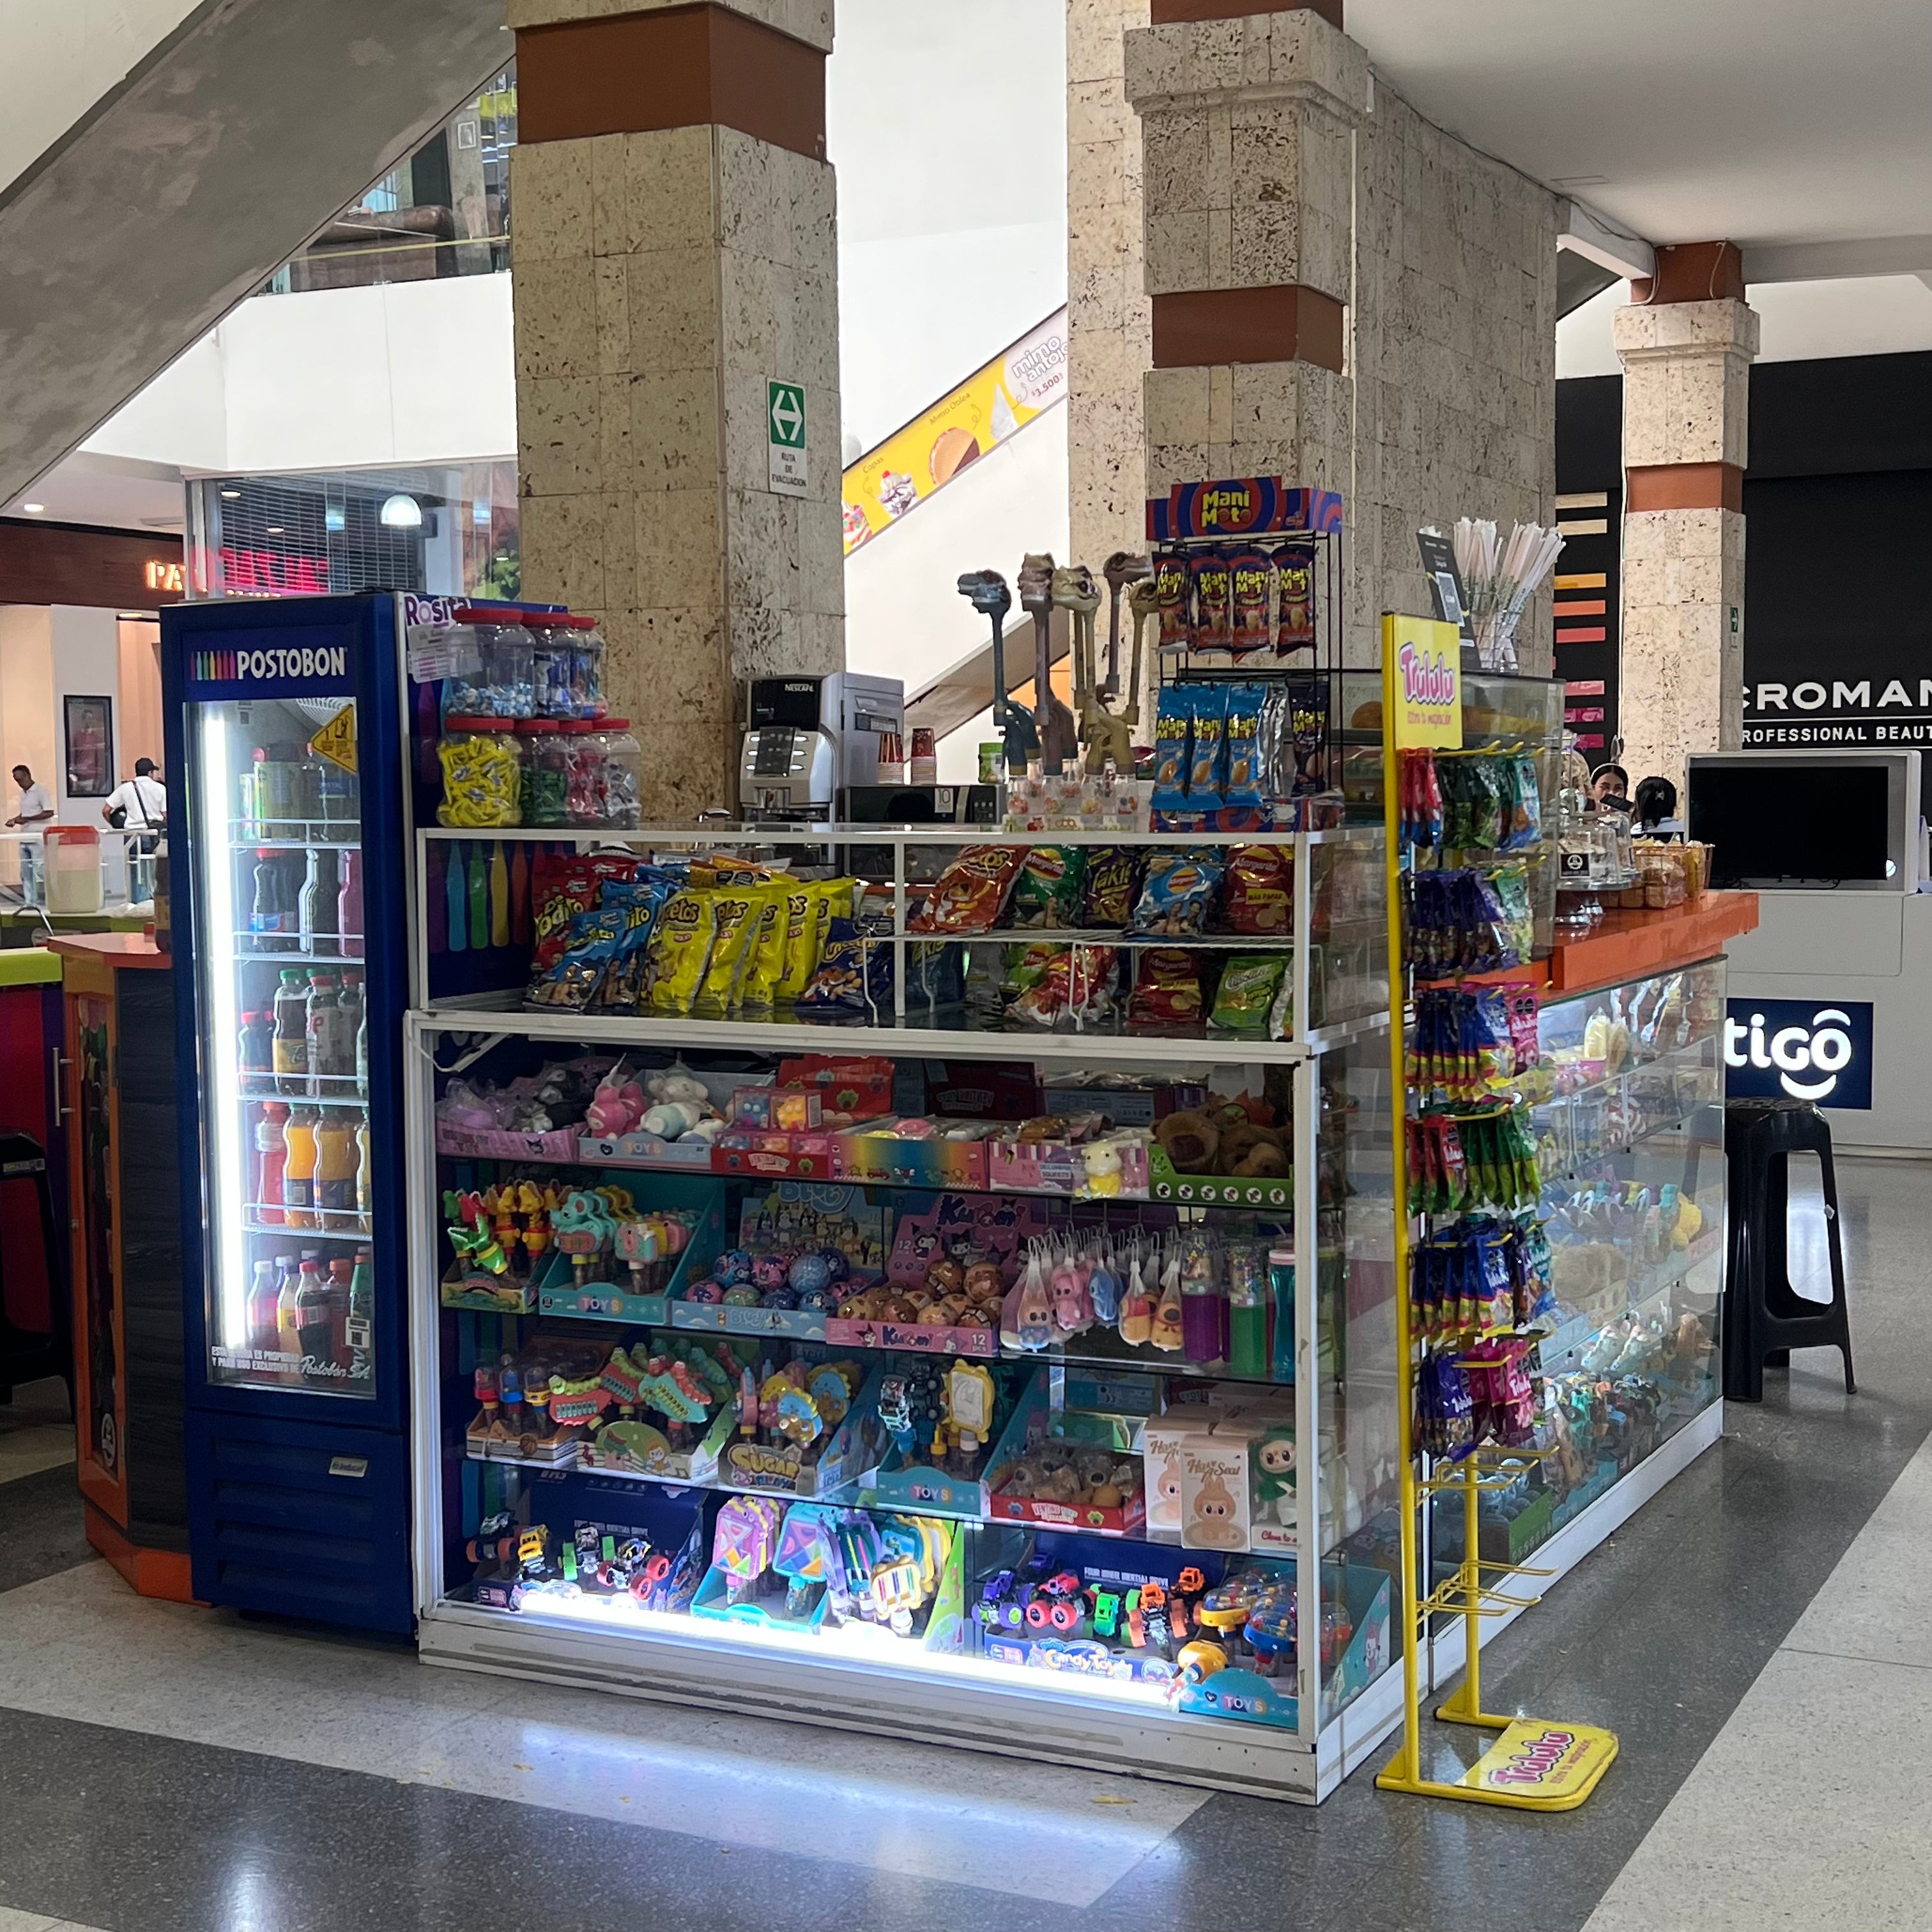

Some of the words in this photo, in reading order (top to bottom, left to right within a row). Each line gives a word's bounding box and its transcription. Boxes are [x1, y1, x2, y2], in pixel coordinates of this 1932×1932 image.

[1012, 336, 1061, 378] mimo
[781, 452, 797, 463] RUTA
[785, 464, 793, 474] DE
[146, 561, 187, 591] PA
[1399, 641, 1455, 705] Trululu
[1742, 679, 1932, 710] ROMA
[1742, 727, 1867, 743] ROFESSIONAL
[938, 789, 951, 804] 10
[625, 1141, 661, 1155] TOYS
[582, 1296, 620, 1312] TOYS
[972, 1333, 986, 1346] 12
[730, 1445, 800, 1480] SUGAR
[1214, 1462, 1241, 1476] Seat
[914, 1485, 949, 1502] TOYS
[1224, 1696, 1264, 1713] TOYS
[1489, 1731, 1576, 1784] Trululu
